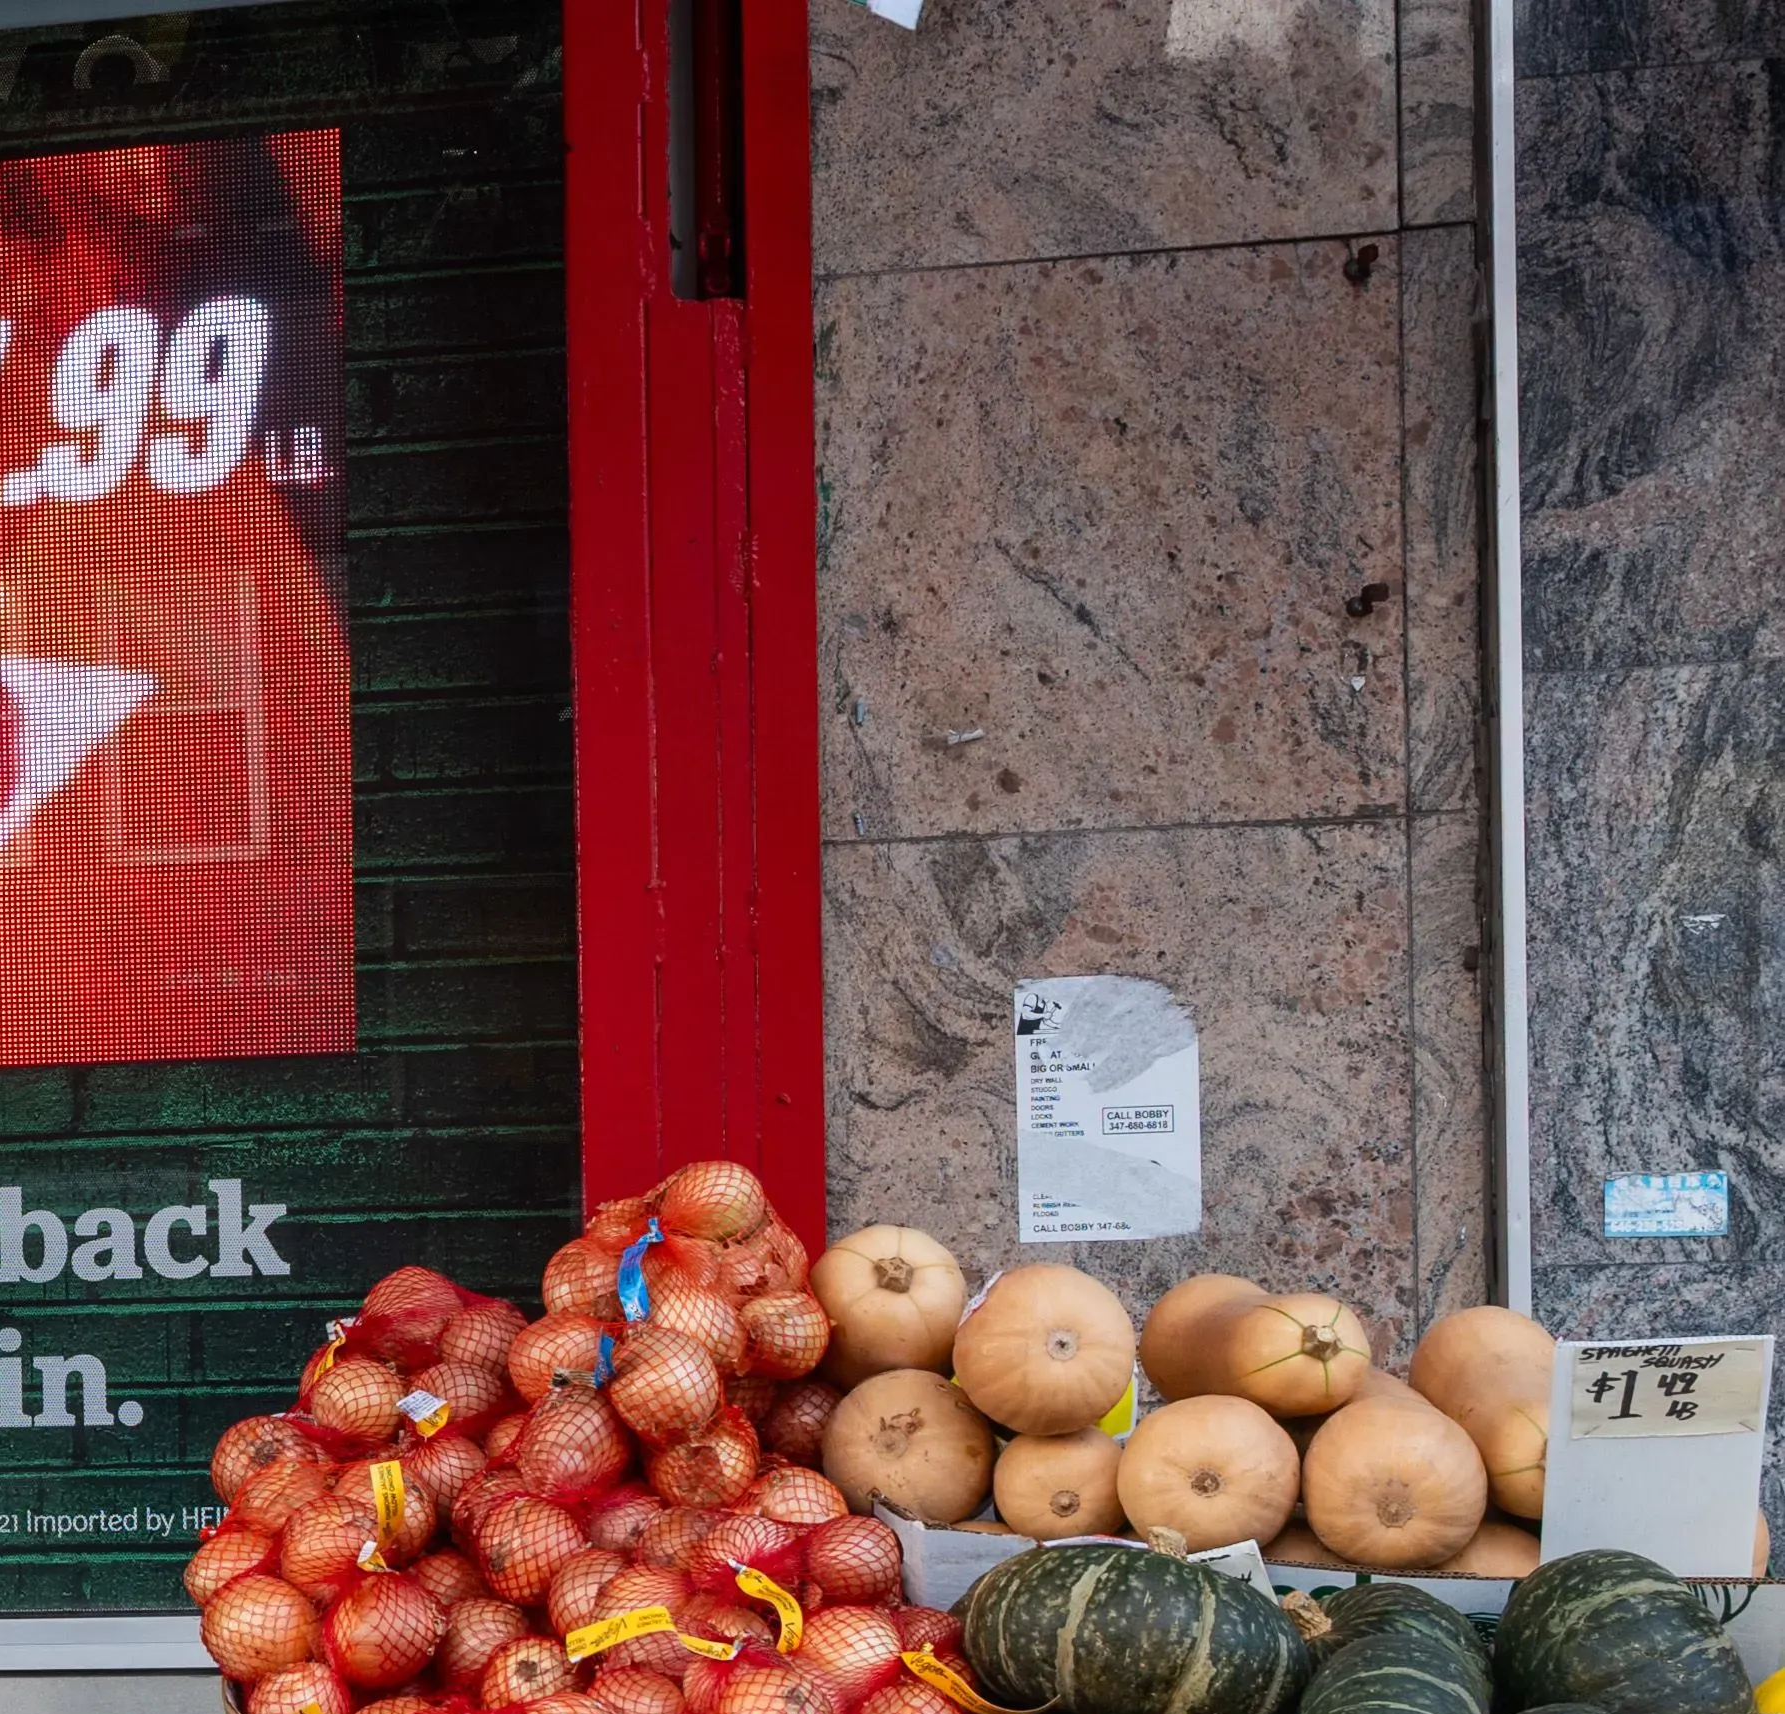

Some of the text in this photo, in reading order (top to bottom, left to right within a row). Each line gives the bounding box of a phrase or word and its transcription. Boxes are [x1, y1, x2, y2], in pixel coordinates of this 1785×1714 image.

[1031, 1064, 1047, 1073] BIG
[1049, 1063, 1064, 1072] OR
[1107, 1109, 1169, 1120] CALL BOBBY
[1033, 1222, 1094, 1233] CALL BOBBY
[1640, 1353, 1725, 1369] SQUASH
[27, 1506, 138, 1538] Imported
[146, 1507, 176, 1537] by
